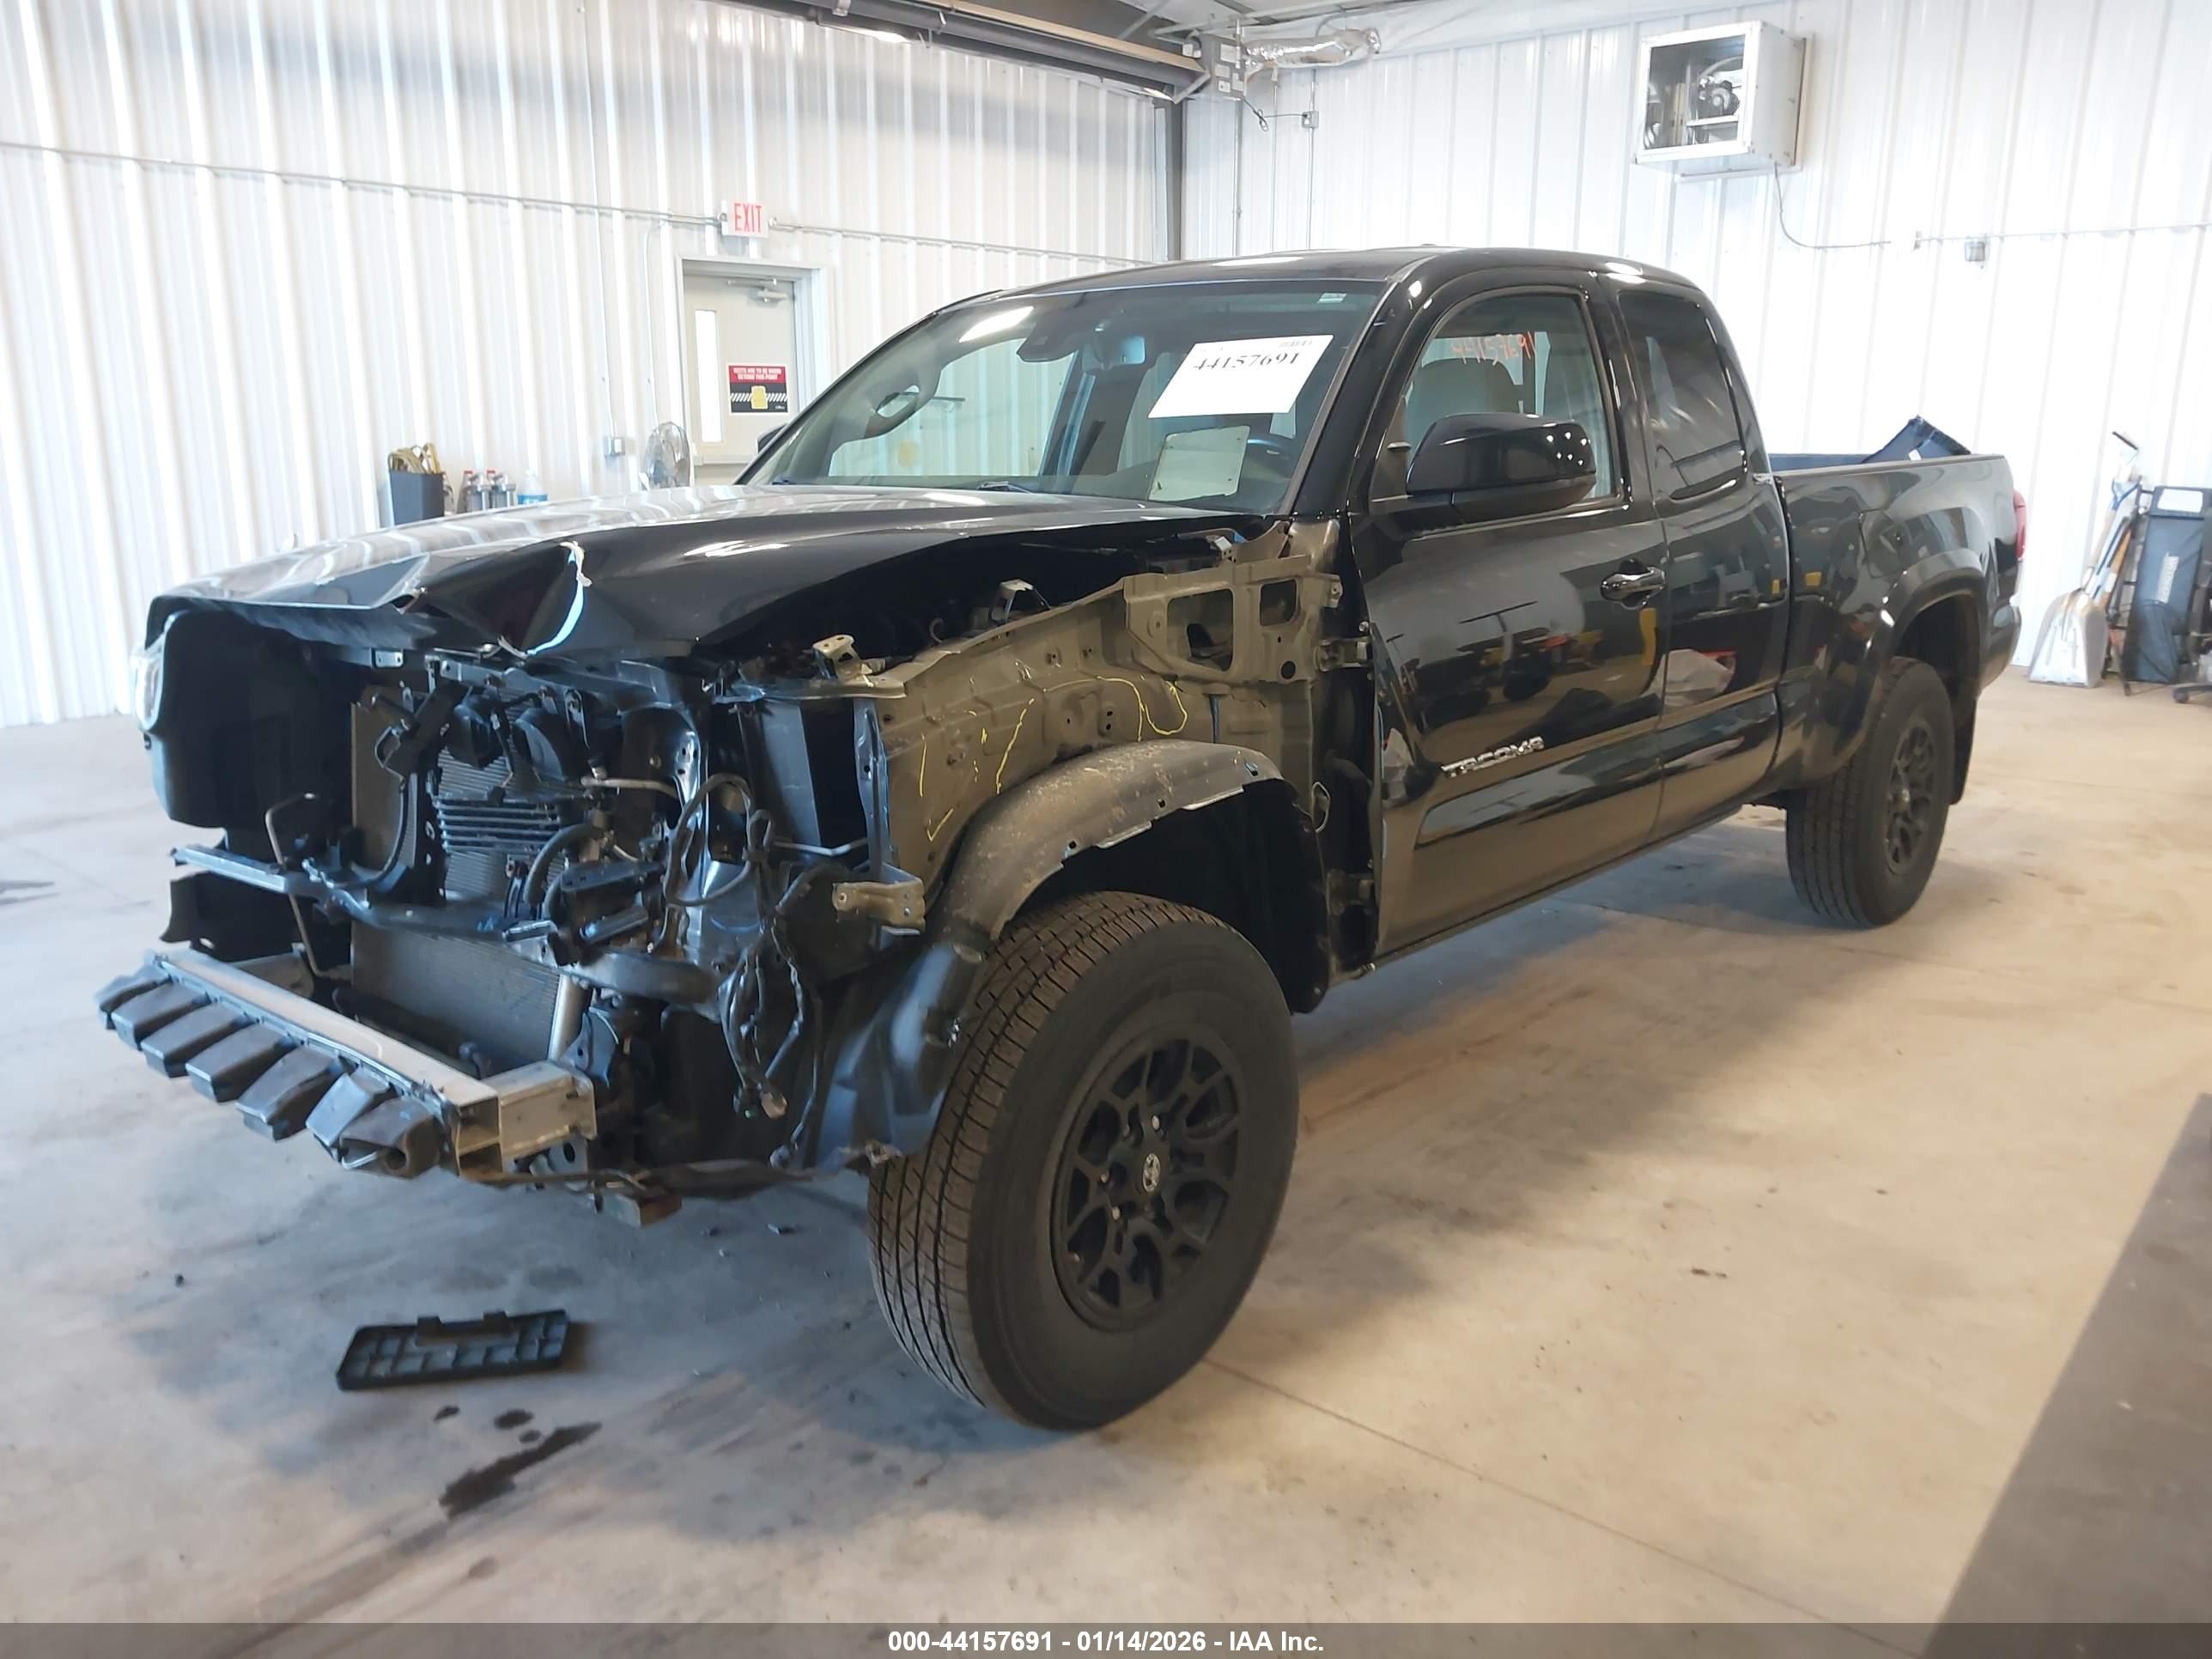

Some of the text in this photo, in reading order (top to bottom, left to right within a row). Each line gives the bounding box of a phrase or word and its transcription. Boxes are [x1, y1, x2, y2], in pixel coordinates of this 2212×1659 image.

[734, 203, 763, 233] EXIT
[1193, 352, 1300, 370] 44157691
[1441, 736, 1545, 778] TACOMA
